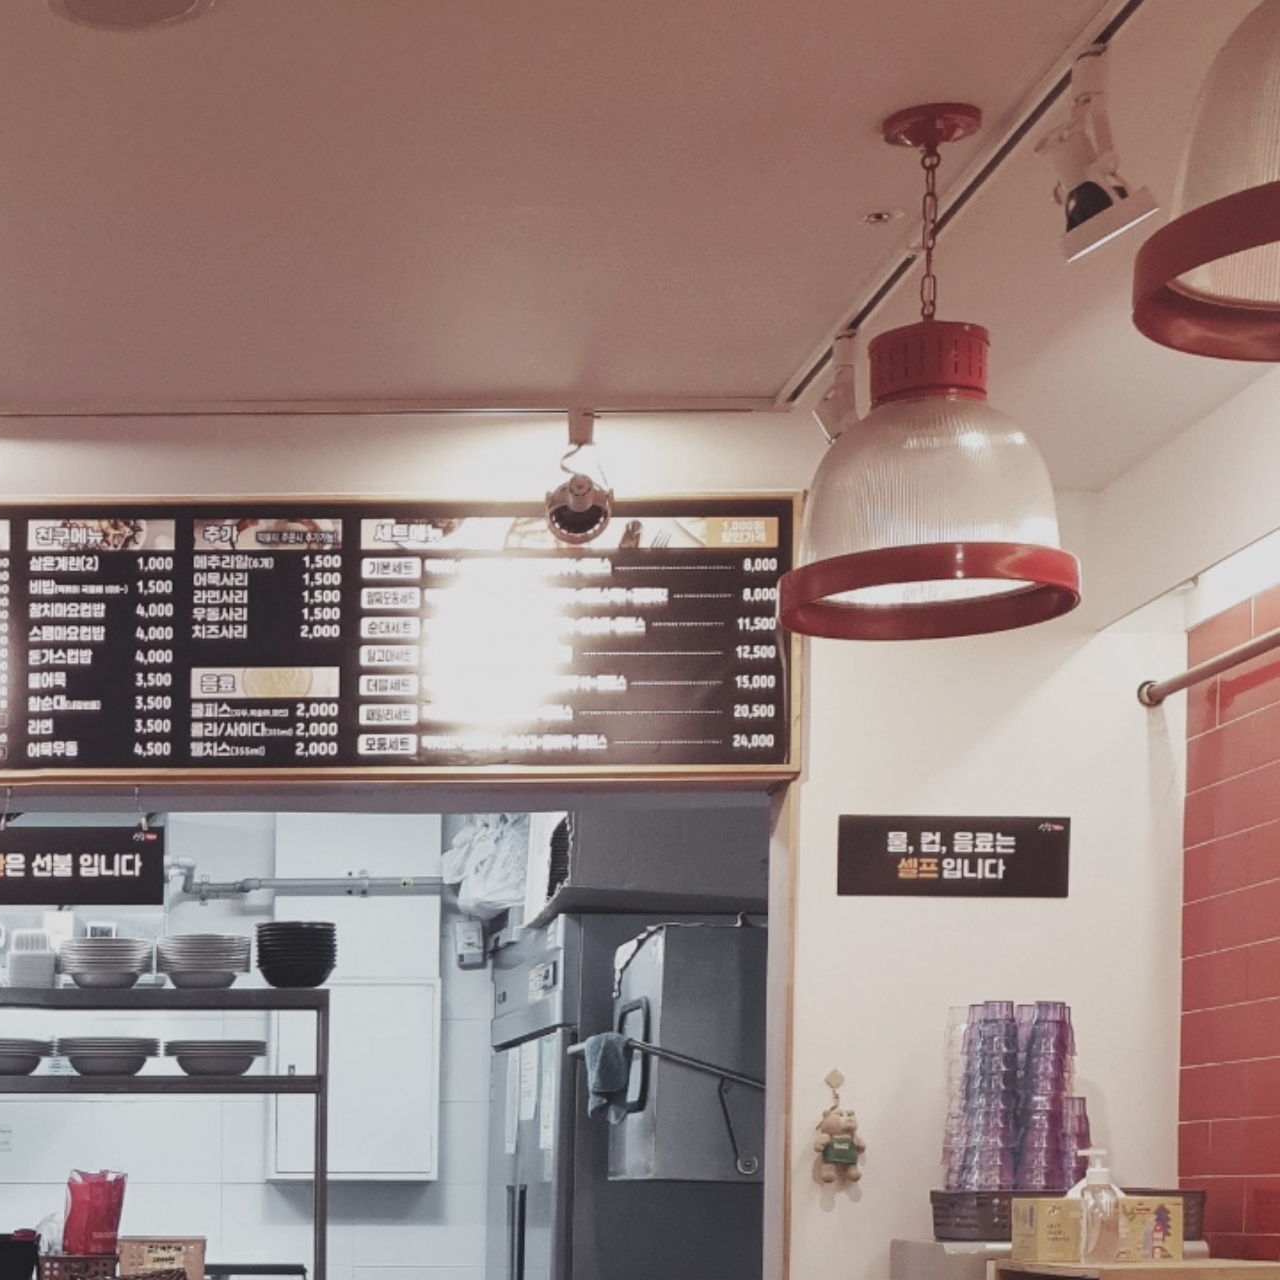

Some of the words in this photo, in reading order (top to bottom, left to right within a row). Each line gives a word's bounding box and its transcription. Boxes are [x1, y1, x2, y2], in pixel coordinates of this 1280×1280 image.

[36, 527, 103, 545] 친구메뉴
[203, 525, 239, 543] 추가
[373, 523, 444, 542] 세트메뉴
[29, 556, 99, 571] 삶은계란(2)
[137, 557, 173, 571] 1,000
[302, 555, 342, 569] 1,500
[369, 561, 414, 575] 기본세트
[743, 558, 778, 573] 8,000
[193, 572, 248, 586] 어묵사리
[302, 572, 342, 586] 1,500
[137, 580, 173, 595] 1,500
[742, 588, 777, 603] 8,000
[193, 590, 248, 604] 라면사리
[301, 590, 341, 604] 1,500
[29, 602, 106, 618] 참치마요컵밥
[136, 603, 173, 618] 4,000
[192, 607, 248, 621] 우동사리
[301, 607, 340, 621] 1,500
[28, 625, 105, 641] 스팸마요컵밥
[135, 626, 173, 642] 4,000
[192, 624, 247, 639] 치즈사리
[300, 625, 340, 639] 2,000
[368, 620, 412, 635] 순대세트
[737, 617, 776, 632] 11,500
[28, 649, 93, 665] 돈가스컵밥
[135, 650, 173, 665] 4,000
[735, 644, 776, 660] 12,500
[135, 673, 172, 688] 3,500
[201, 673, 236, 693] 음료
[366, 678, 411, 692] 더블세트
[735, 675, 776, 690] 15,000
[134, 696, 171, 711] 3,500
[296, 703, 339, 718] 2,000
[366, 708, 411, 723] 패밀리세트
[733, 704, 775, 719] 20,500
[28, 718, 54, 734] 라면
[134, 719, 171, 734] 3,500
[295, 722, 338, 737] 2,000
[27, 741, 78, 757] 어묵우동
[133, 742, 171, 757] 4,500
[295, 742, 338, 757] 2,000
[733, 734, 774, 749] 24,000
[886, 831, 914, 854] 물,
[920, 831, 947, 854] 컵,
[953, 831, 1016, 854] 음료는
[31, 853, 73, 877] 선불
[79, 852, 142, 877] 입니다
[898, 858, 939, 879] 셀프
[942, 857, 1006, 880] 입니다
